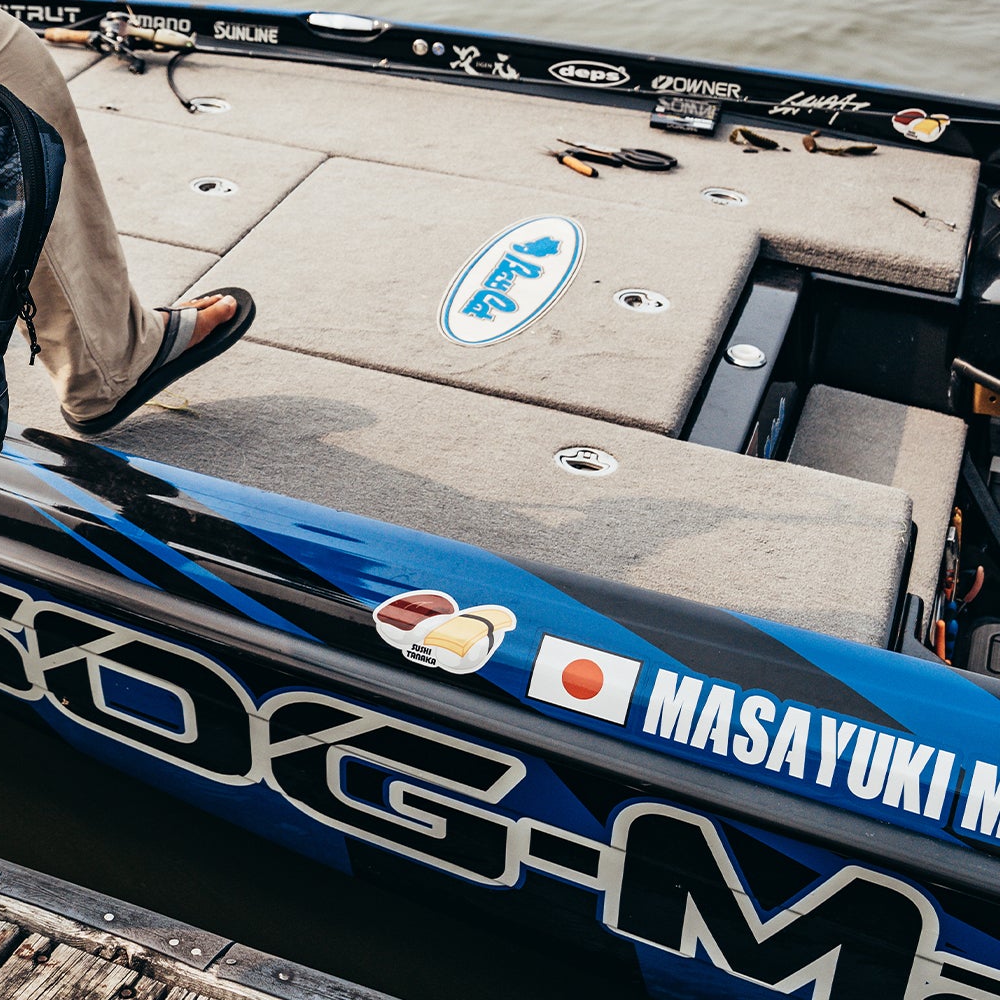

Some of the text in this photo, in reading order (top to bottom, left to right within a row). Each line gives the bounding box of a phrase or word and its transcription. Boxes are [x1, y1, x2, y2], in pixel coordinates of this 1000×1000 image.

[213, 20, 279, 44] SUNLINE
[558, 65, 620, 82] deps
[673, 77, 742, 99] OWNER
[406, 650, 437, 665] TANAKA
[411, 643, 432, 656] SUSHI
[643, 667, 956, 821] MASAYUKI
